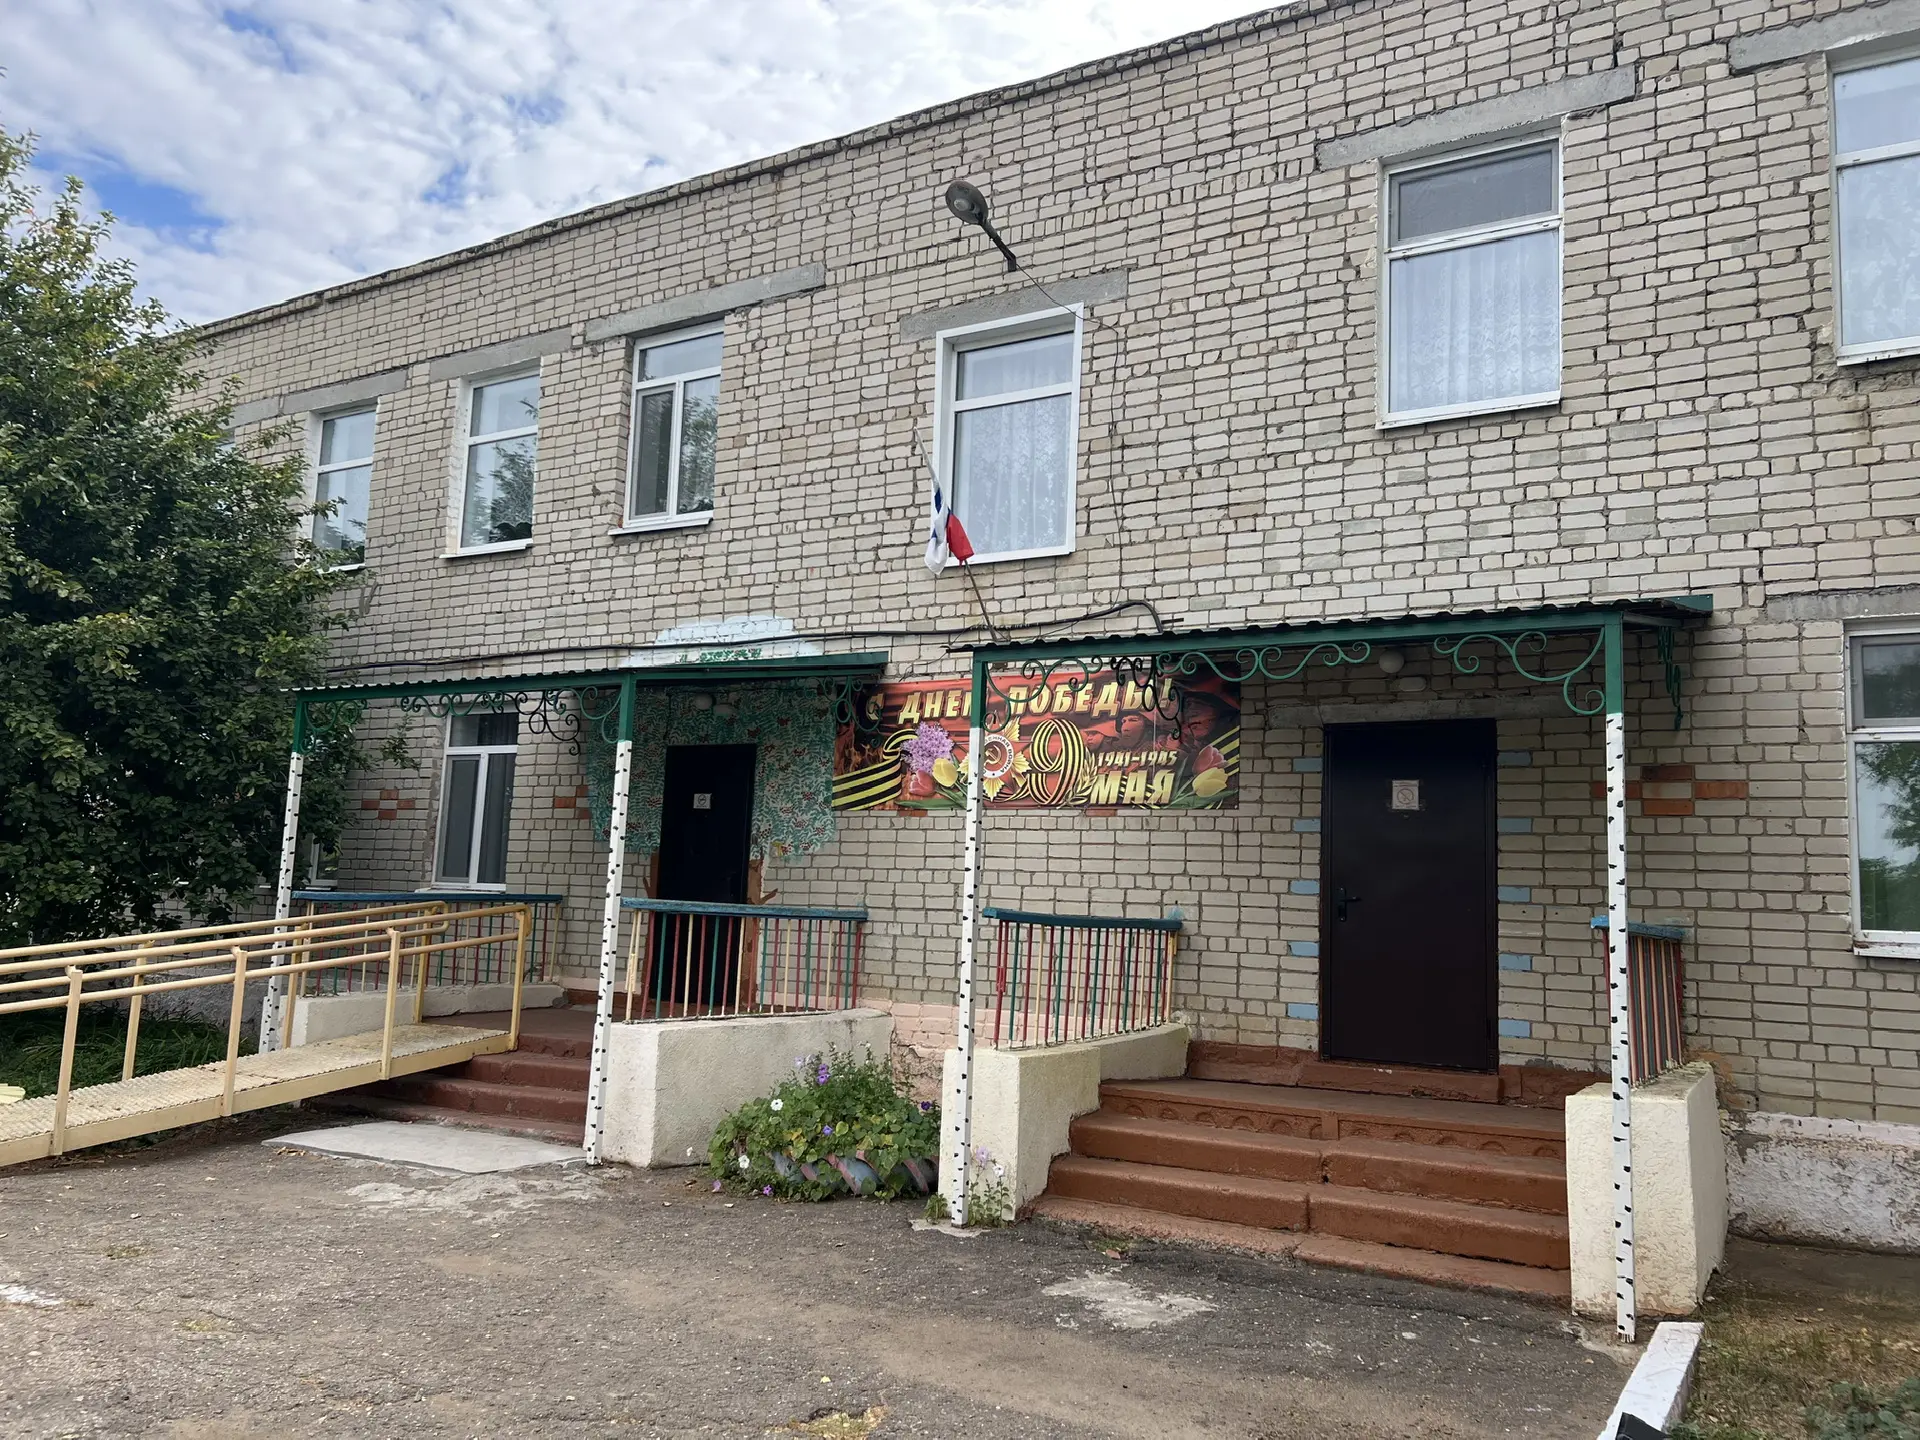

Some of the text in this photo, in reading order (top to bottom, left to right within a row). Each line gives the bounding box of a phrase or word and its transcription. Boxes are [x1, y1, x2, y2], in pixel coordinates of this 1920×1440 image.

[1007, 678, 1173, 717] ПОБЕДЫ!
[1029, 718, 1176, 805] 9 МАЯ
[1097, 750, 1178, 767] 1941-1945
